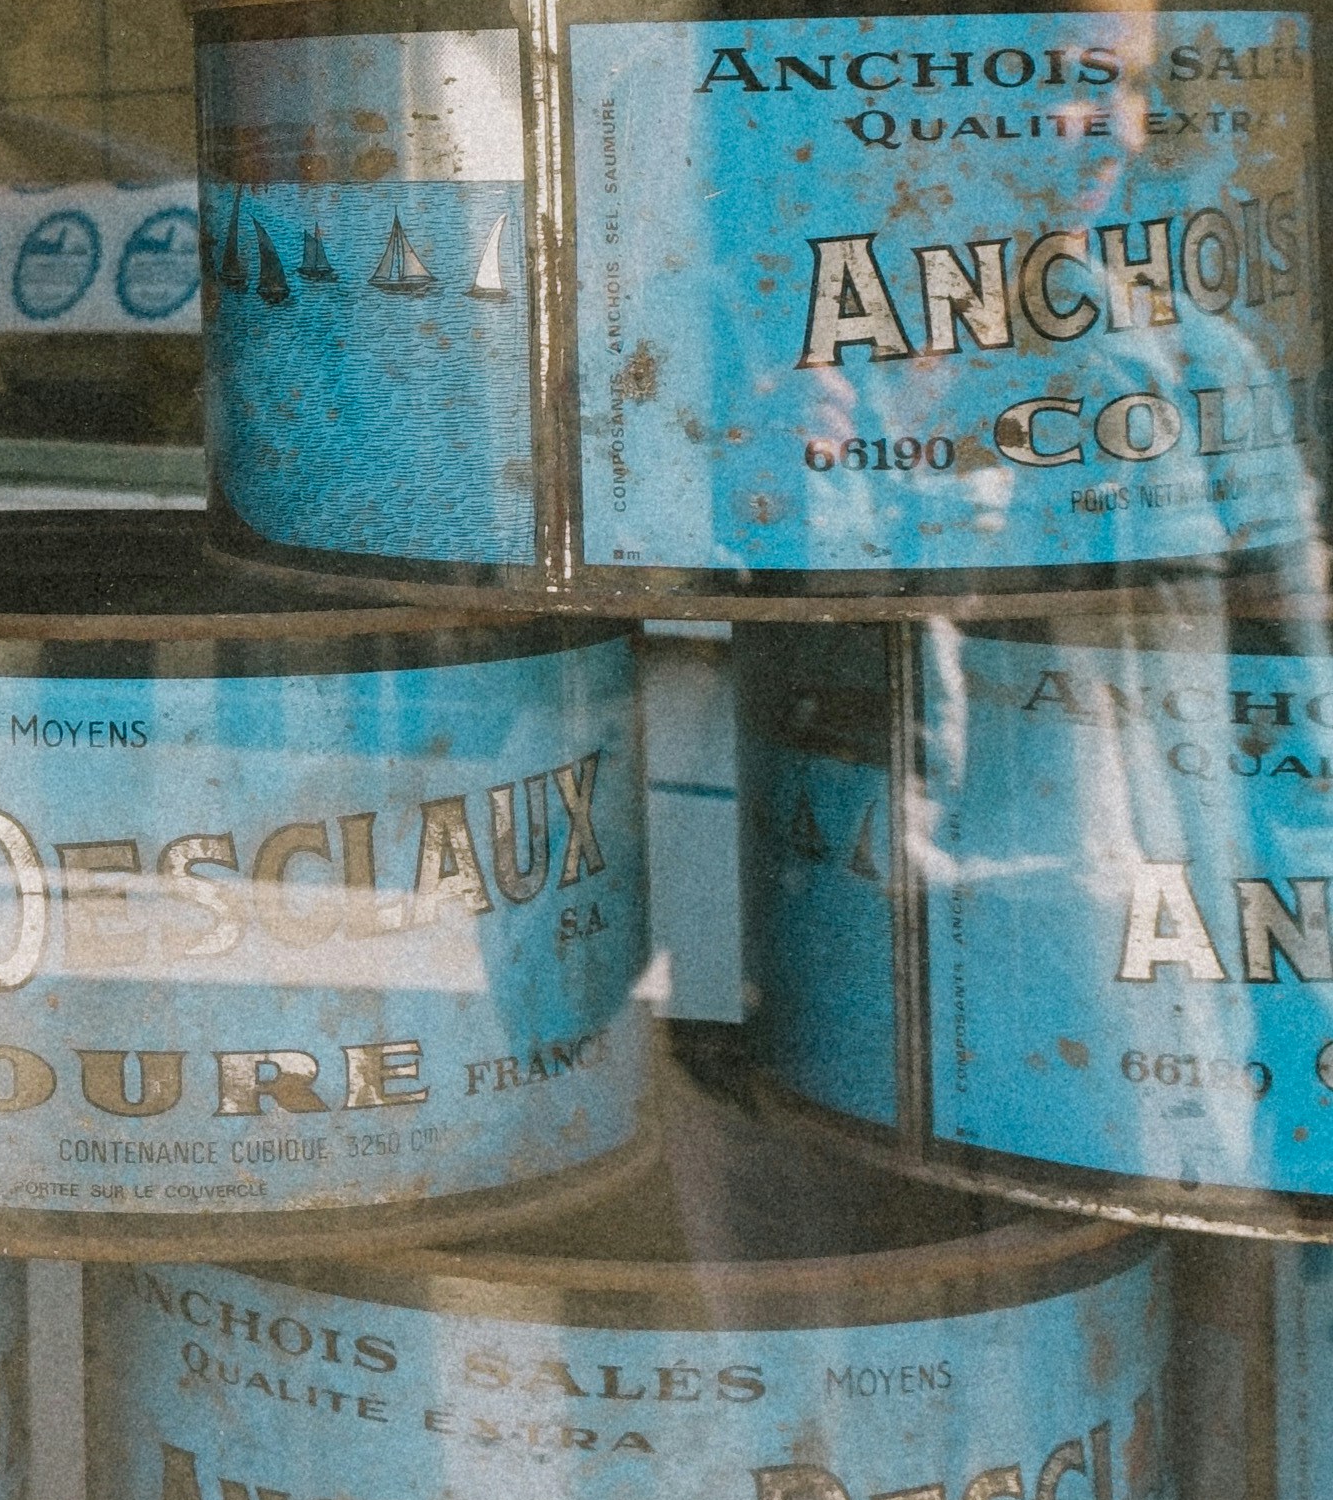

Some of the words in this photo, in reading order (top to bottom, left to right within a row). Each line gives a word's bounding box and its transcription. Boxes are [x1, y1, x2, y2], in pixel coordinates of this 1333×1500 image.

[693, 45, 1120, 95] ANCHOIS
[600, 97, 619, 195] SAUMURE
[851, 107, 1111, 151] QUALITÉ
[793, 190, 1297, 371] ANCHOIS
[805, 435, 957, 473] 66190
[10, 714, 149, 749] MOYENS
[58, 1136, 219, 1166] CONTENANCE
[232, 1136, 329, 1165] CUBIQUE
[90, 1180, 127, 1199] SUR
[135, 1180, 155, 1198] LE
[463, 1348, 767, 1403] SALÉS
[825, 1360, 953, 1399] MOYENS
